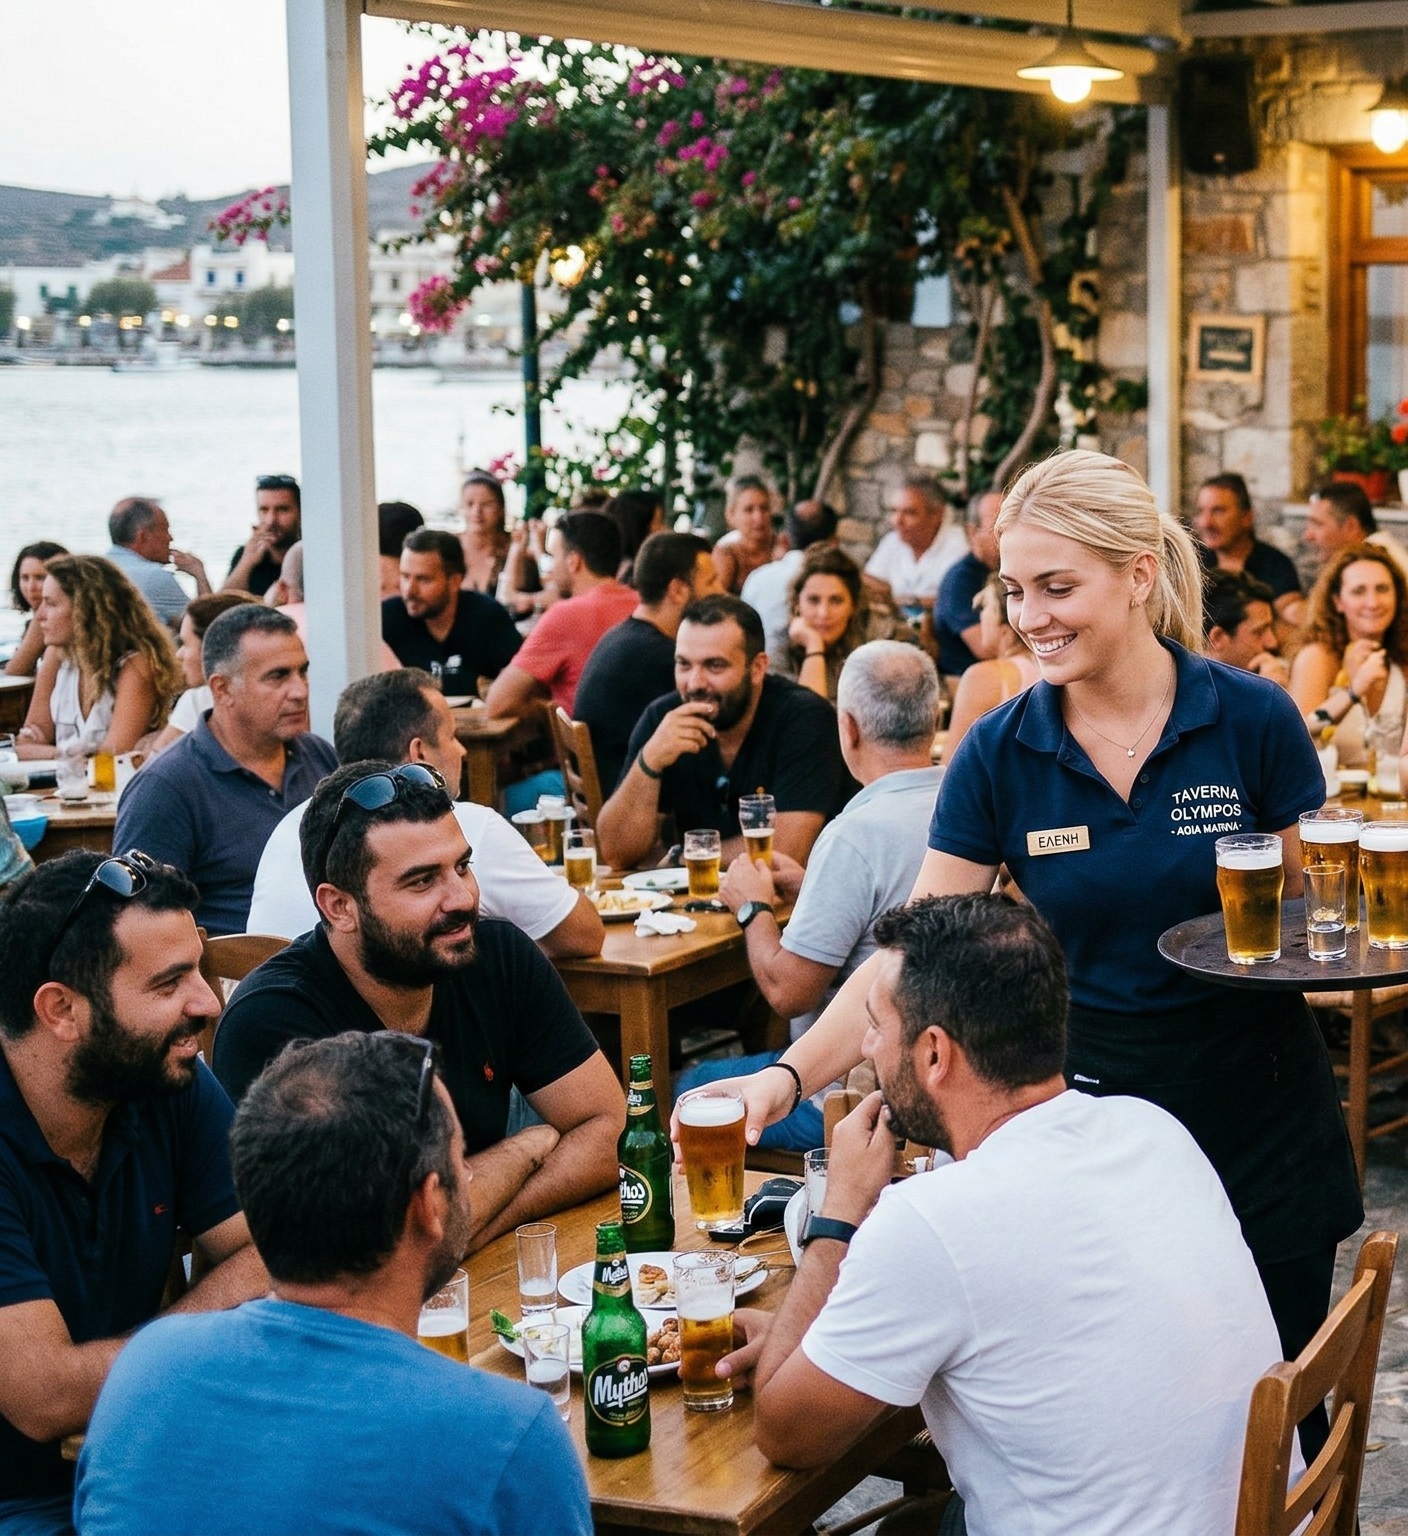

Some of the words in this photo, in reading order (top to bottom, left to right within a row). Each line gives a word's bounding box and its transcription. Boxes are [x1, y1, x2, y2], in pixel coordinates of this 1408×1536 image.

[1171, 785, 1240, 805] TAVERNA
[1170, 803, 1242, 821] OLYMPOS
[1038, 832, 1079, 848] ΕΛΕΝΗ
